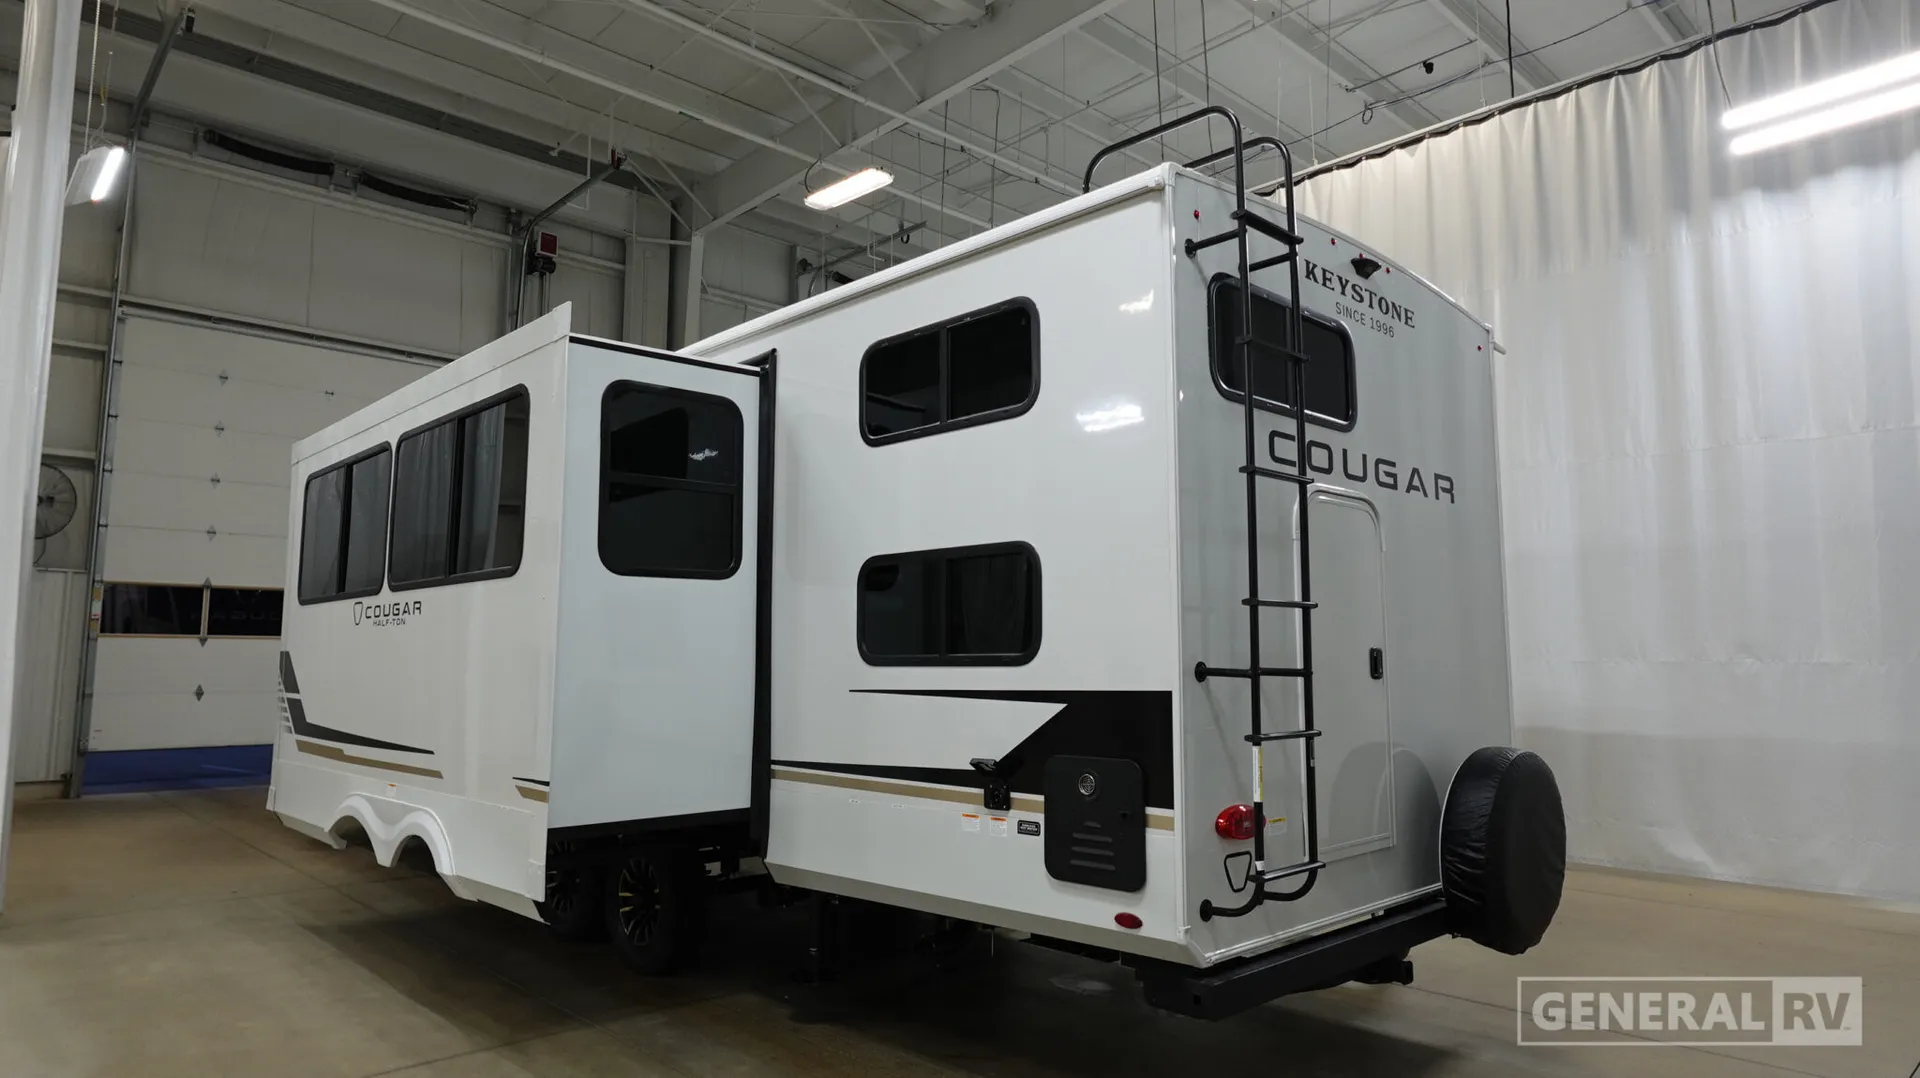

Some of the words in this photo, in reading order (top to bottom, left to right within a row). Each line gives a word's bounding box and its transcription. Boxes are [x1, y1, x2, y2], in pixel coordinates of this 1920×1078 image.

[1304, 259, 1415, 329] KEYSTONE
[1335, 301, 1366, 326] SINCE
[1370, 317, 1395, 338] 1996
[1268, 429, 1455, 504] COUGAR
[365, 601, 422, 619] COUGAR
[373, 618, 406, 627] HALF-TON
